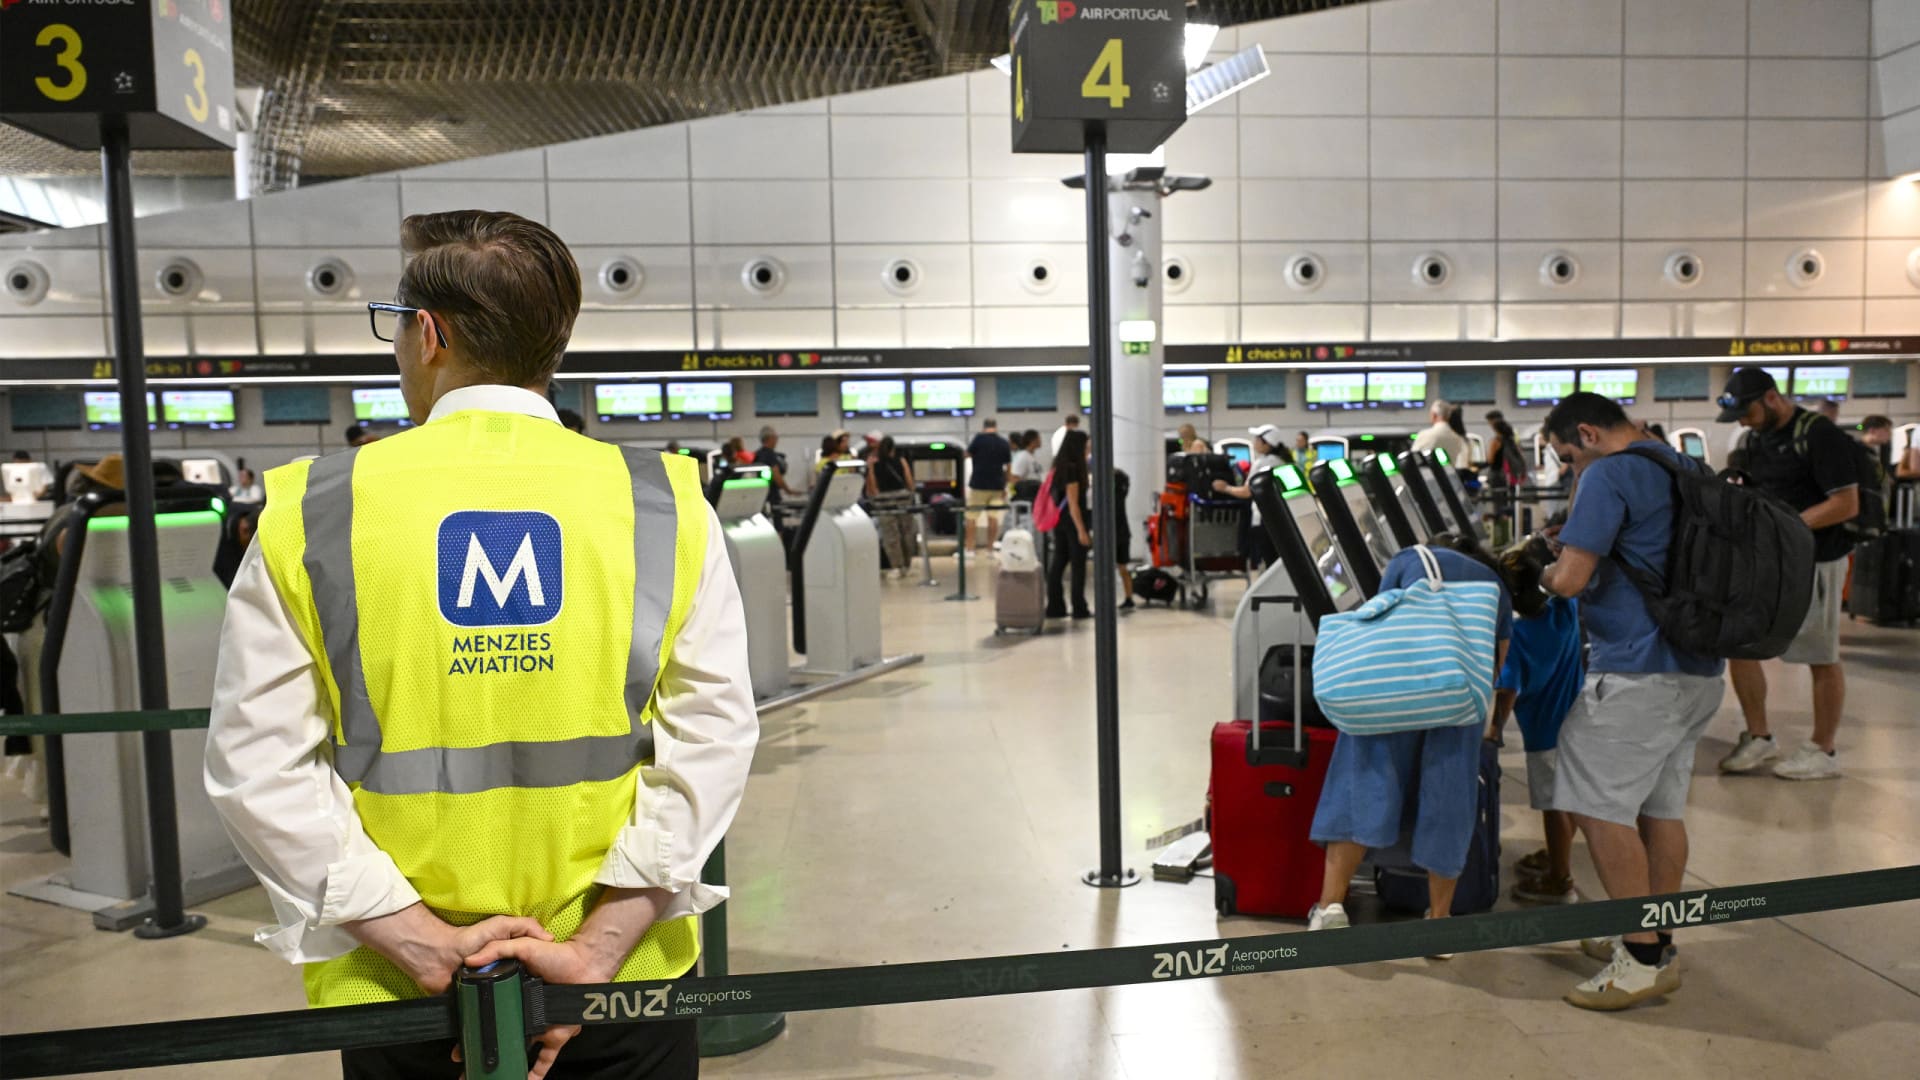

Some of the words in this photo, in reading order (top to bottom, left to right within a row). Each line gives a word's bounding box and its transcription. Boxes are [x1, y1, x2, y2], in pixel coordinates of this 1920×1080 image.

[1037, 1, 1077, 25] TAP
[35, 23, 87, 101] 3
[1081, 38, 1131, 109] 4
[183, 48, 209, 123] 3
[1247, 346, 1302, 361] check-in
[1749, 340, 1801, 354] check-in
[704, 354, 764, 368] check-in
[457, 532, 546, 609] M
[453, 633, 551, 653] MENZIES
[448, 655, 554, 675] AVIATION
[1710, 895, 1767, 911] Aeroportos
[1710, 911, 1730, 921] Lisboa
[1232, 946, 1298, 963] Aeroportos
[1231, 964, 1255, 972] Lisboa
[675, 989, 752, 1005] Aeroportos
[675, 1006, 702, 1015] Lisboa
